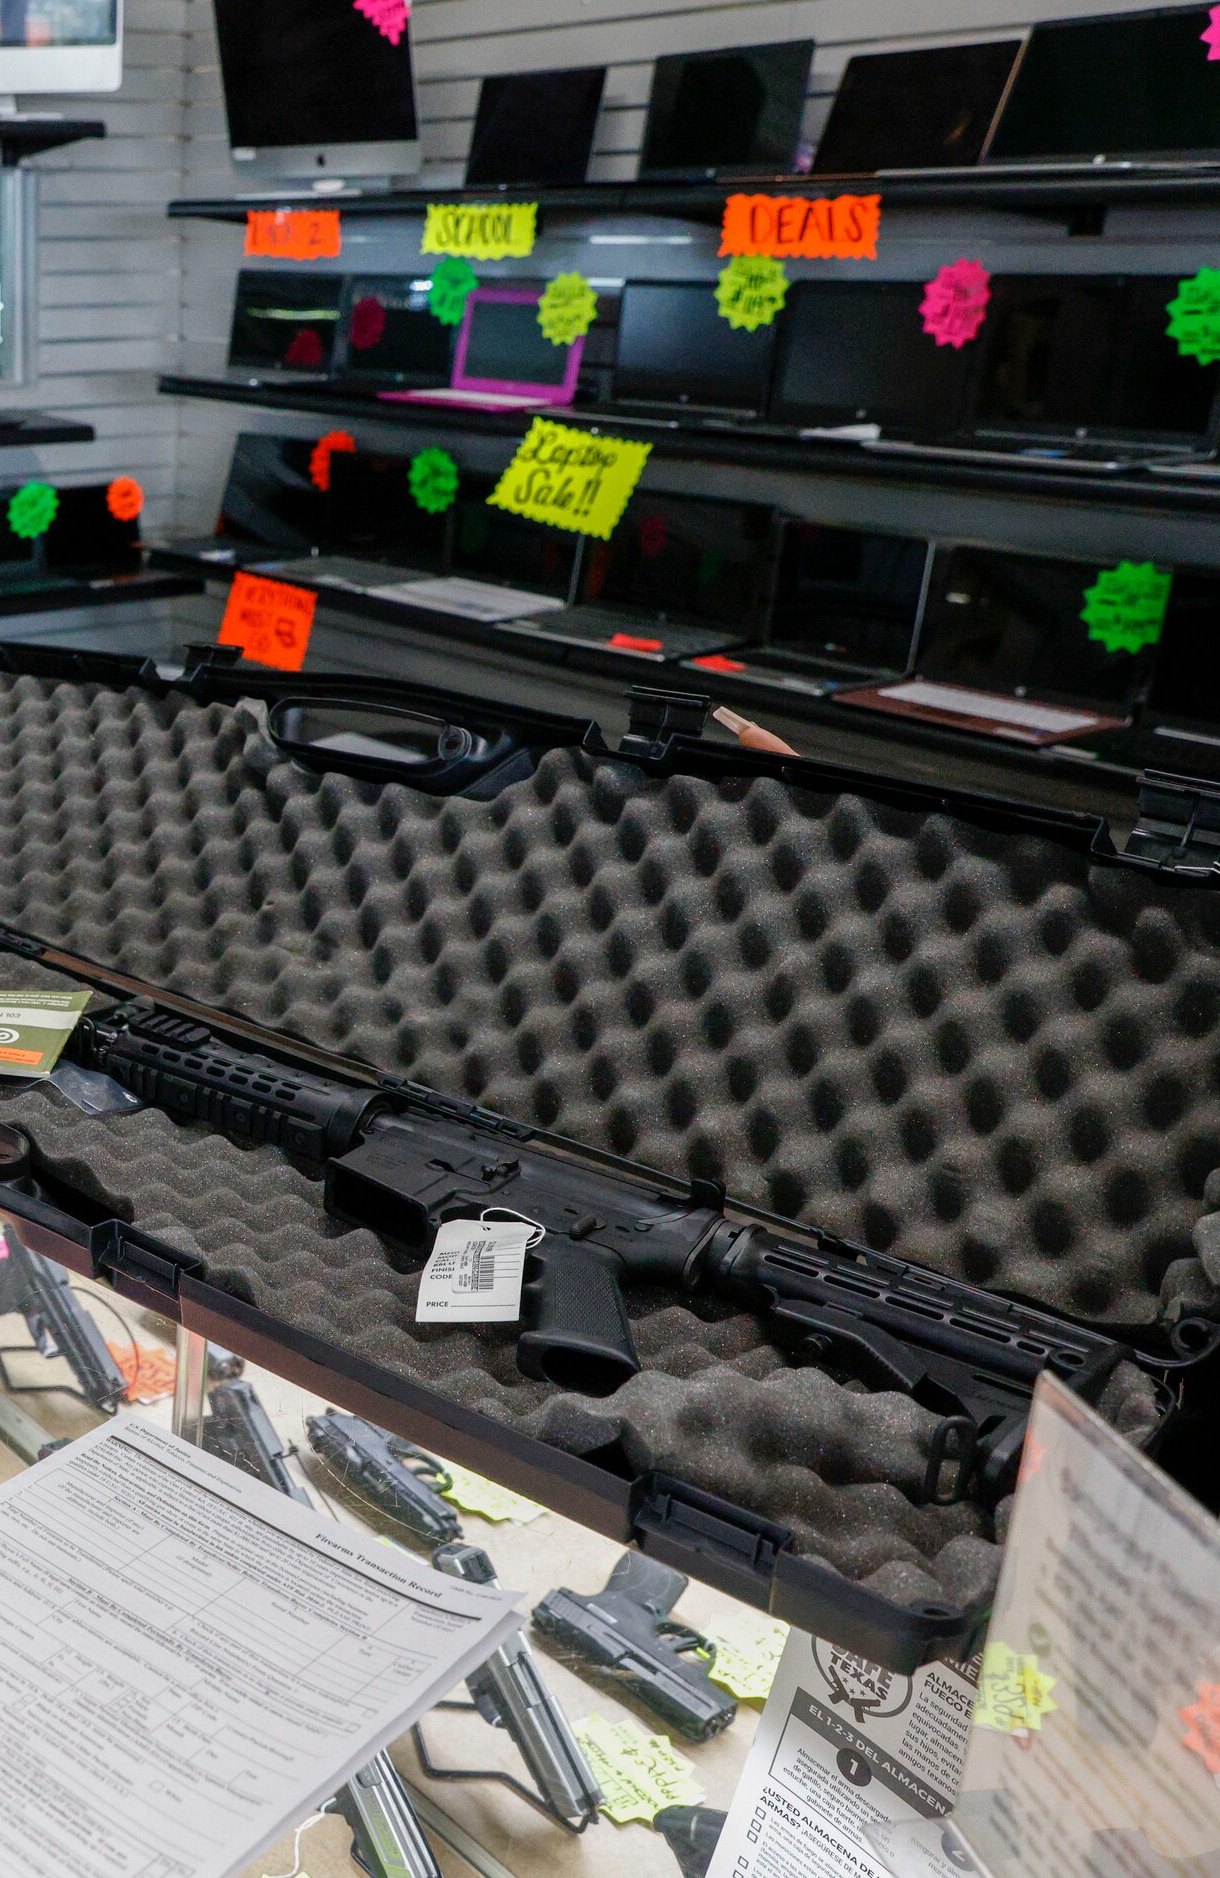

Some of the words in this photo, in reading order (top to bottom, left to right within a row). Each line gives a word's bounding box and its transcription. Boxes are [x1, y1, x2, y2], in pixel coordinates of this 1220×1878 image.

[436, 205, 517, 247] SCHOOL
[749, 202, 867, 244] DEALS
[518, 430, 618, 478] Laptop
[513, 468, 603, 516] Sale!!
[138, 1428, 169, 1445] Department
[172, 1447, 192, 1458] Justice
[315, 1533, 356, 1555] Firearms
[354, 1553, 409, 1582] Transaction
[407, 1580, 443, 1598] Record
[828, 1649, 888, 1702] TEXAS
[923, 1678, 963, 1713] FUEGO
[809, 1704, 824, 1721] EL
[825, 1716, 853, 1743] 1-2-3
[855, 1739, 880, 1763] DEL
[908, 1719, 929, 1741] lugar,
[911, 1709, 961, 1752] equivocadas.
[919, 1691, 929, 1703] La
[929, 1698, 968, 1734] seguridad
[847, 1758, 858, 1776] 1
[901, 1737, 913, 1750] las
[913, 1747, 939, 1771] manos
[940, 1767, 950, 1779] de
[905, 1729, 919, 1743] sus
[918, 1739, 940, 1761] hijos,
[792, 1763, 801, 1774] de
[801, 1770, 822, 1791] gatillo,
[822, 1788, 844, 1809] seguro
[796, 1756, 828, 1786] asegurada
[828, 1782, 860, 1810] utilizando
[860, 1807, 869, 1817] un
[797, 1746, 830, 1775] Almacenar
[830, 1773, 837, 1782] el
[837, 1779, 854, 1795] arma
[897, 1746, 926, 1773] amigos
[926, 1769, 956, 1796] texanos
[782, 1765, 809, 1790] estuche,
[809, 1787, 820, 1799] una
[821, 1796, 835, 1811] caja
[835, 1807, 856, 1828] fuerte,
[805, 1794, 833, 1819] gabinete
[833, 1816, 841, 1825] de
[842, 1824, 862, 1843] armas.
[759, 1794, 800, 1831] ARMAS?
[800, 1827, 843, 1866] ¡ASEGÚRESE
[843, 1863, 853, 1874] DE
[762, 1784, 800, 1818] ¿USTED
[801, 1814, 858, 1865] ALMACENA
[859, 1862, 875, 1878] DE
